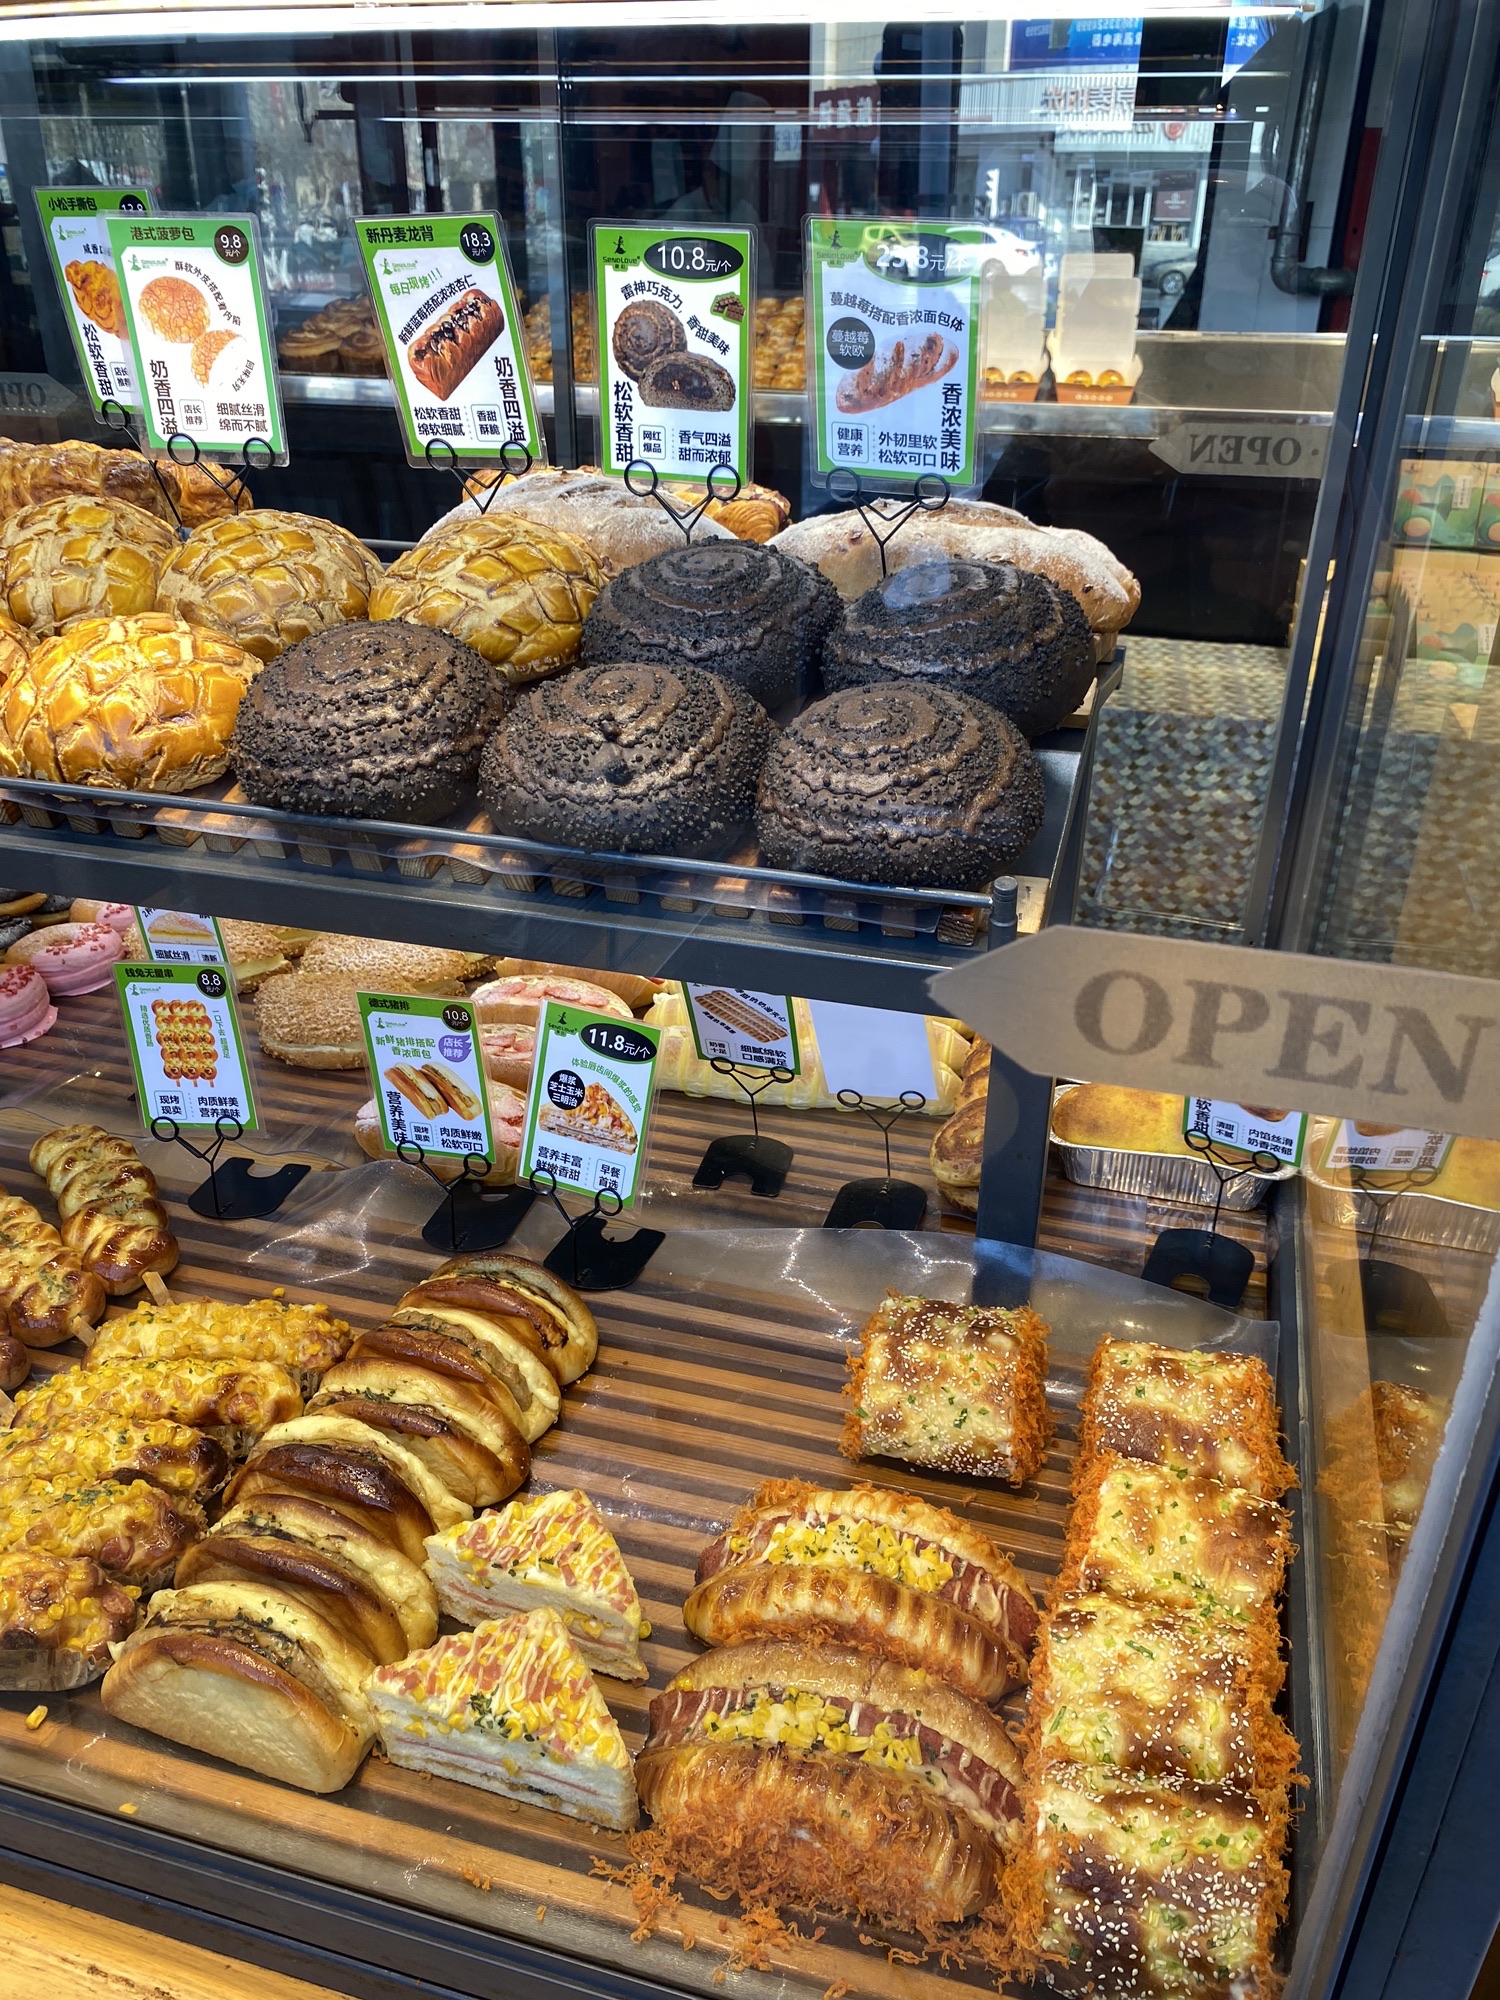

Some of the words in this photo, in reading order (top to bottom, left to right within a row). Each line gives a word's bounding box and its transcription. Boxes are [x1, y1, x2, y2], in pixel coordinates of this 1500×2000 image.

[48, 197, 98, 212] 小松手撕包
[130, 226, 195, 241] 港式菠萝包
[365, 225, 434, 244] 新丹麦龙背
[462, 230, 491, 248] 18.3
[220, 234, 242, 249] 9.8
[224, 249, 241, 257] 元/个
[471, 248, 487, 257] 元/个
[657, 245, 732, 273] 10.8元/个
[398, 274, 477, 345] 新鲜蓝莓搭配浓浓杏仁
[829, 291, 966, 333] 蔓越莓搭配香浓面包体
[686, 314, 731, 356] 香甜美味
[831, 329, 869, 344] 蔓越莓
[839, 343, 865, 358] 软欧
[82, 323, 114, 397] 松软香甜
[114, 366, 128, 377] 店长
[150, 359, 179, 435] 奶香四溢
[494, 356, 526, 442] 奶香四溢
[183, 404, 202, 414] 店长
[216, 402, 265, 417] 细腻丝滑
[413, 406, 461, 421] 松软香甜
[476, 410, 498, 422] 香甜
[185, 415, 204, 426] 推荐
[218, 418, 268, 433] 绵而不腻
[614, 380, 634, 463] 松软香甜
[940, 383, 963, 472] 香浓美味
[417, 423, 465, 437] 绵软细腻
[479, 423, 500, 436] 酥脆
[643, 430, 662, 441] 网红
[837, 427, 864, 442] 健康
[678, 430, 732, 447] 香气四溢
[878, 431, 938, 450] 外韧里软
[643, 443, 662, 454] 爆品
[678, 447, 732, 464] 甜而浓郁
[837, 442, 864, 457] 营养
[878, 449, 937, 467] 松软可口
[155, 949, 190, 961] 细腻丝滑
[200, 973, 222, 987] 8.8
[368, 997, 411, 1012] 德式猪排
[211, 1009, 226, 1036] 一口下去
[445, 1009, 469, 1022] 10.8
[375, 1034, 436, 1049] 新鲜猪排搭配
[443, 1037, 464, 1048] 店长
[588, 1027, 651, 1059] 11.8元/个
[1073, 969, 1498, 1104] OPEN
[392, 1046, 432, 1060] 香浓面包
[443, 1047, 464, 1059] 推荐
[740, 1044, 787, 1059] 细腻绵软
[742, 1053, 787, 1067] 口感满足
[559, 1072, 577, 1086] 爆浆
[548, 1080, 584, 1098] 芝士玉米
[159, 1095, 180, 1105] 现烤
[197, 1095, 239, 1108] 肉质鲜美
[551, 1092, 578, 1107] 三明治
[161, 1105, 182, 1115] 现卖
[199, 1106, 241, 1119] 营养美味
[1194, 1096, 1211, 1133] 软香甜
[386, 1091, 409, 1145] 营养美味
[1216, 1120, 1235, 1131] 清甜
[413, 1125, 430, 1135] 现烤
[440, 1127, 483, 1141] 肉质鲜嫩
[1215, 1128, 1234, 1139] 不腻
[1249, 1127, 1294, 1147] 内馅丝滑
[414, 1133, 431, 1143] 现卖
[441, 1138, 484, 1153] 松软可口
[1247, 1136, 1293, 1156] 奶香浓郁
[537, 1145, 583, 1169] 营养丰富
[535, 1158, 581, 1182] 鲜嫩香甜
[599, 1162, 621, 1179] 早餐
[598, 1175, 619, 1191] 首选
